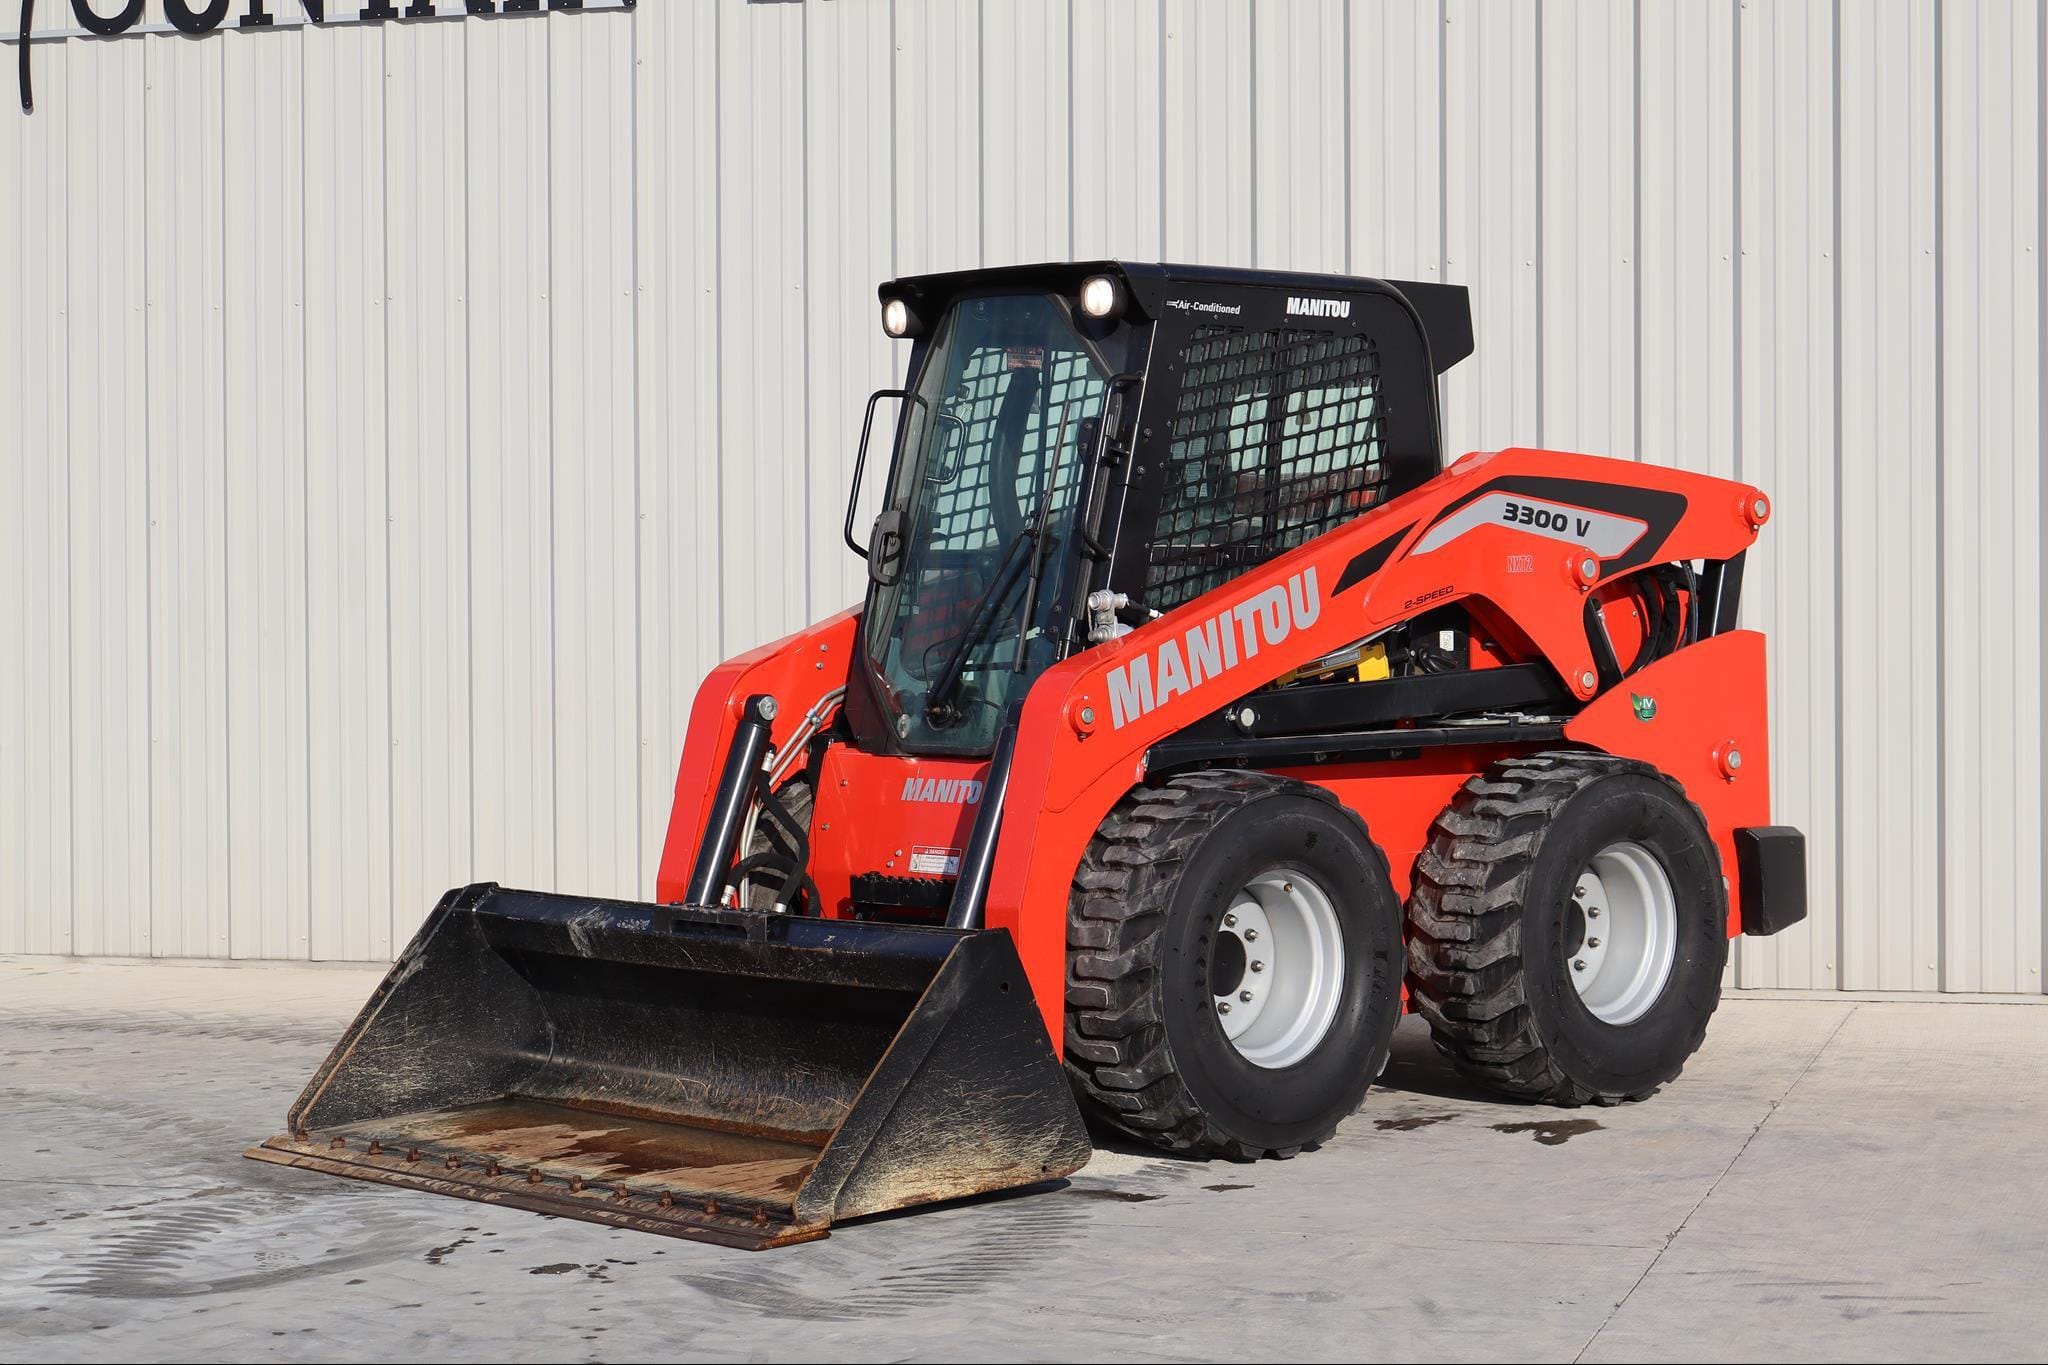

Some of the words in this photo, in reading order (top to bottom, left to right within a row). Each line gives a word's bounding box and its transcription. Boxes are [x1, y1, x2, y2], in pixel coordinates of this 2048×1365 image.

[1177, 300, 1241, 315] Air-Conditioned
[1286, 297, 1351, 318] MANITOU
[1503, 502, 1568, 533] 3300
[1576, 518, 1591, 538] V
[1507, 555, 1534, 573] NXT2
[1404, 585, 1454, 610] 2-SPEED
[1106, 565, 1321, 731] MANITOU
[901, 777, 983, 805] MANITO
